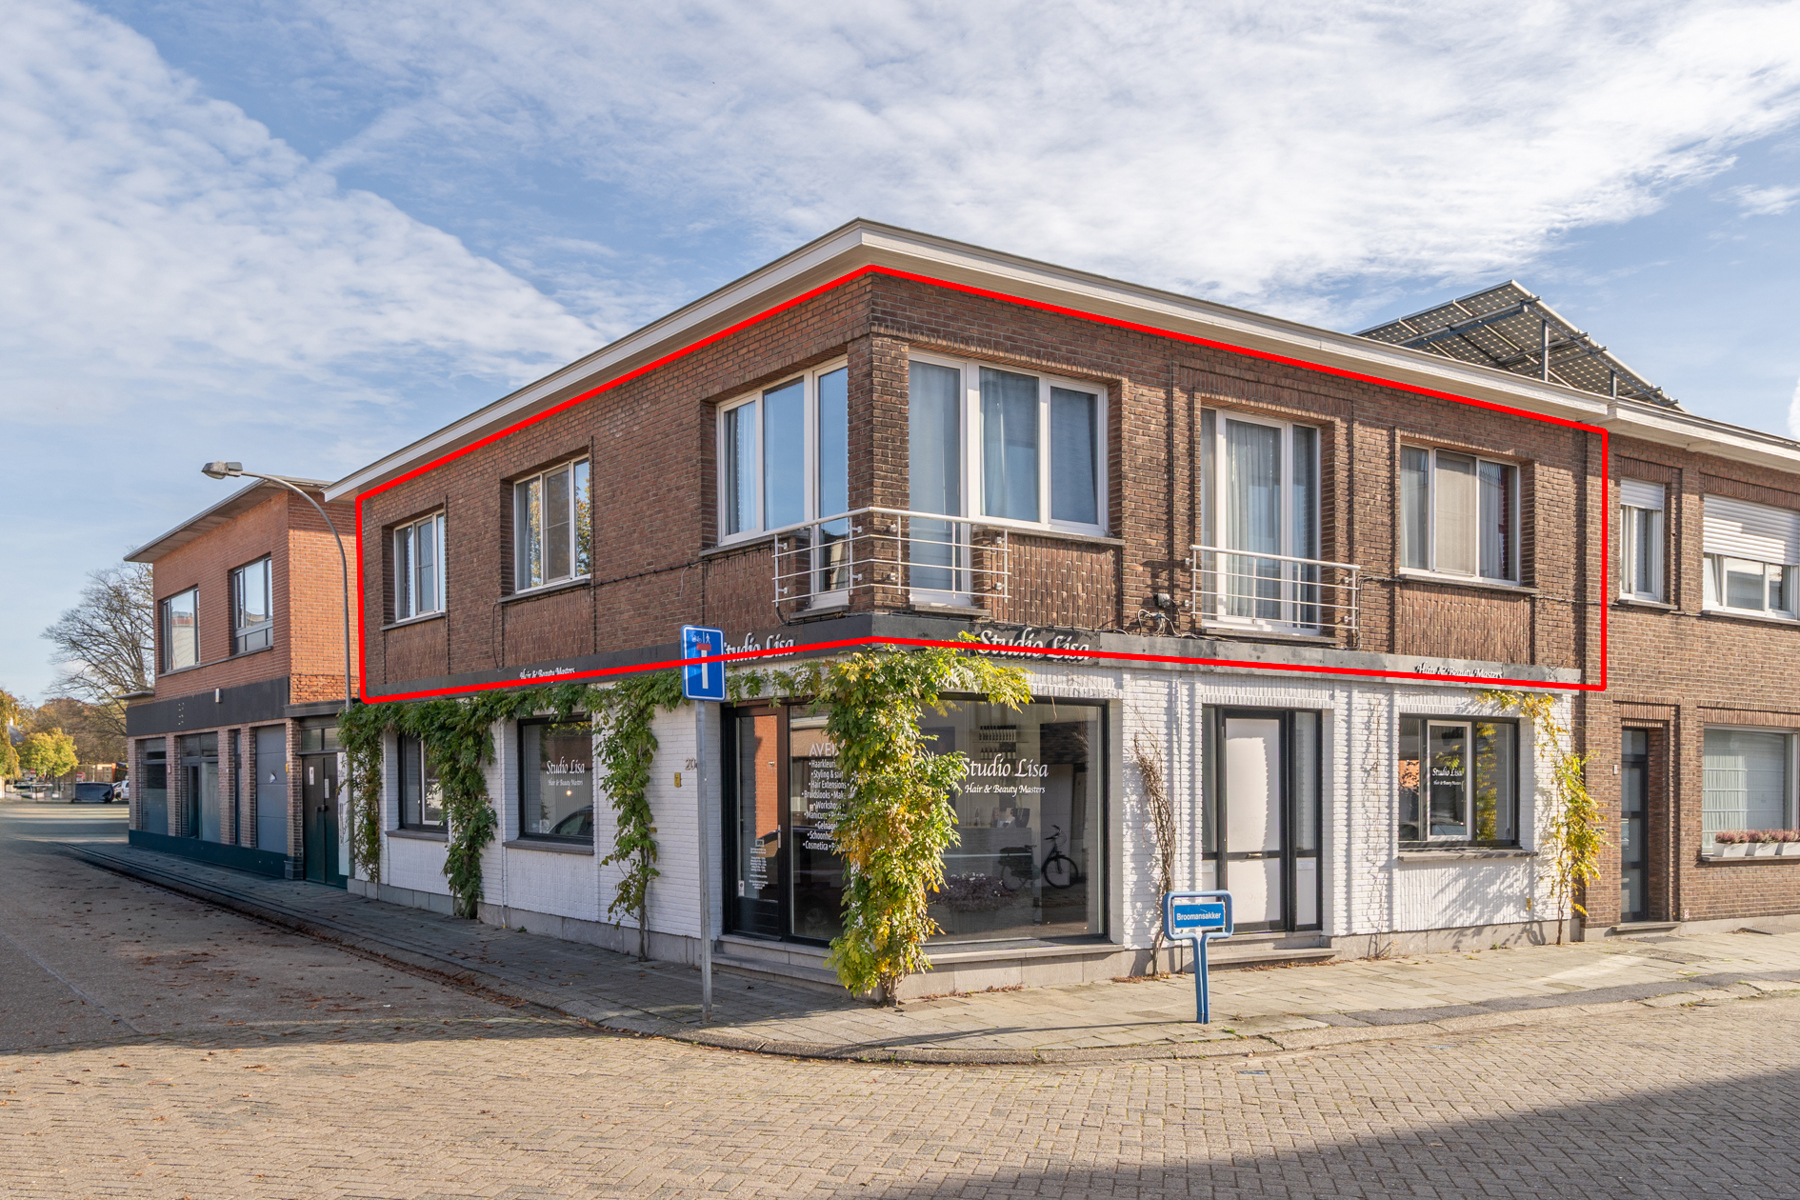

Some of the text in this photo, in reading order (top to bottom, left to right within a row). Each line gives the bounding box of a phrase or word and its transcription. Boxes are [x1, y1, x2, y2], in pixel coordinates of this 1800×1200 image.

[723, 632, 796, 663] tudio Lisa
[977, 627, 1090, 660] Studio Lisa
[808, 743, 840, 757] AVED
[546, 755, 585, 775] Studio Lisa
[810, 759, 837, 768] Haarkleuri
[959, 753, 1050, 778] Studio Lisa
[813, 770, 830, 781] Styling
[829, 770, 835, 779] &
[811, 779, 847, 790] Hair Extensions
[964, 781, 1046, 798] Hair & Beauty Masters
[806, 810, 828, 820] Manicur
[817, 821, 838, 832] Gelnagel
[805, 840, 829, 851] Cosmetica
[1176, 911, 1222, 921] Broomansakker
